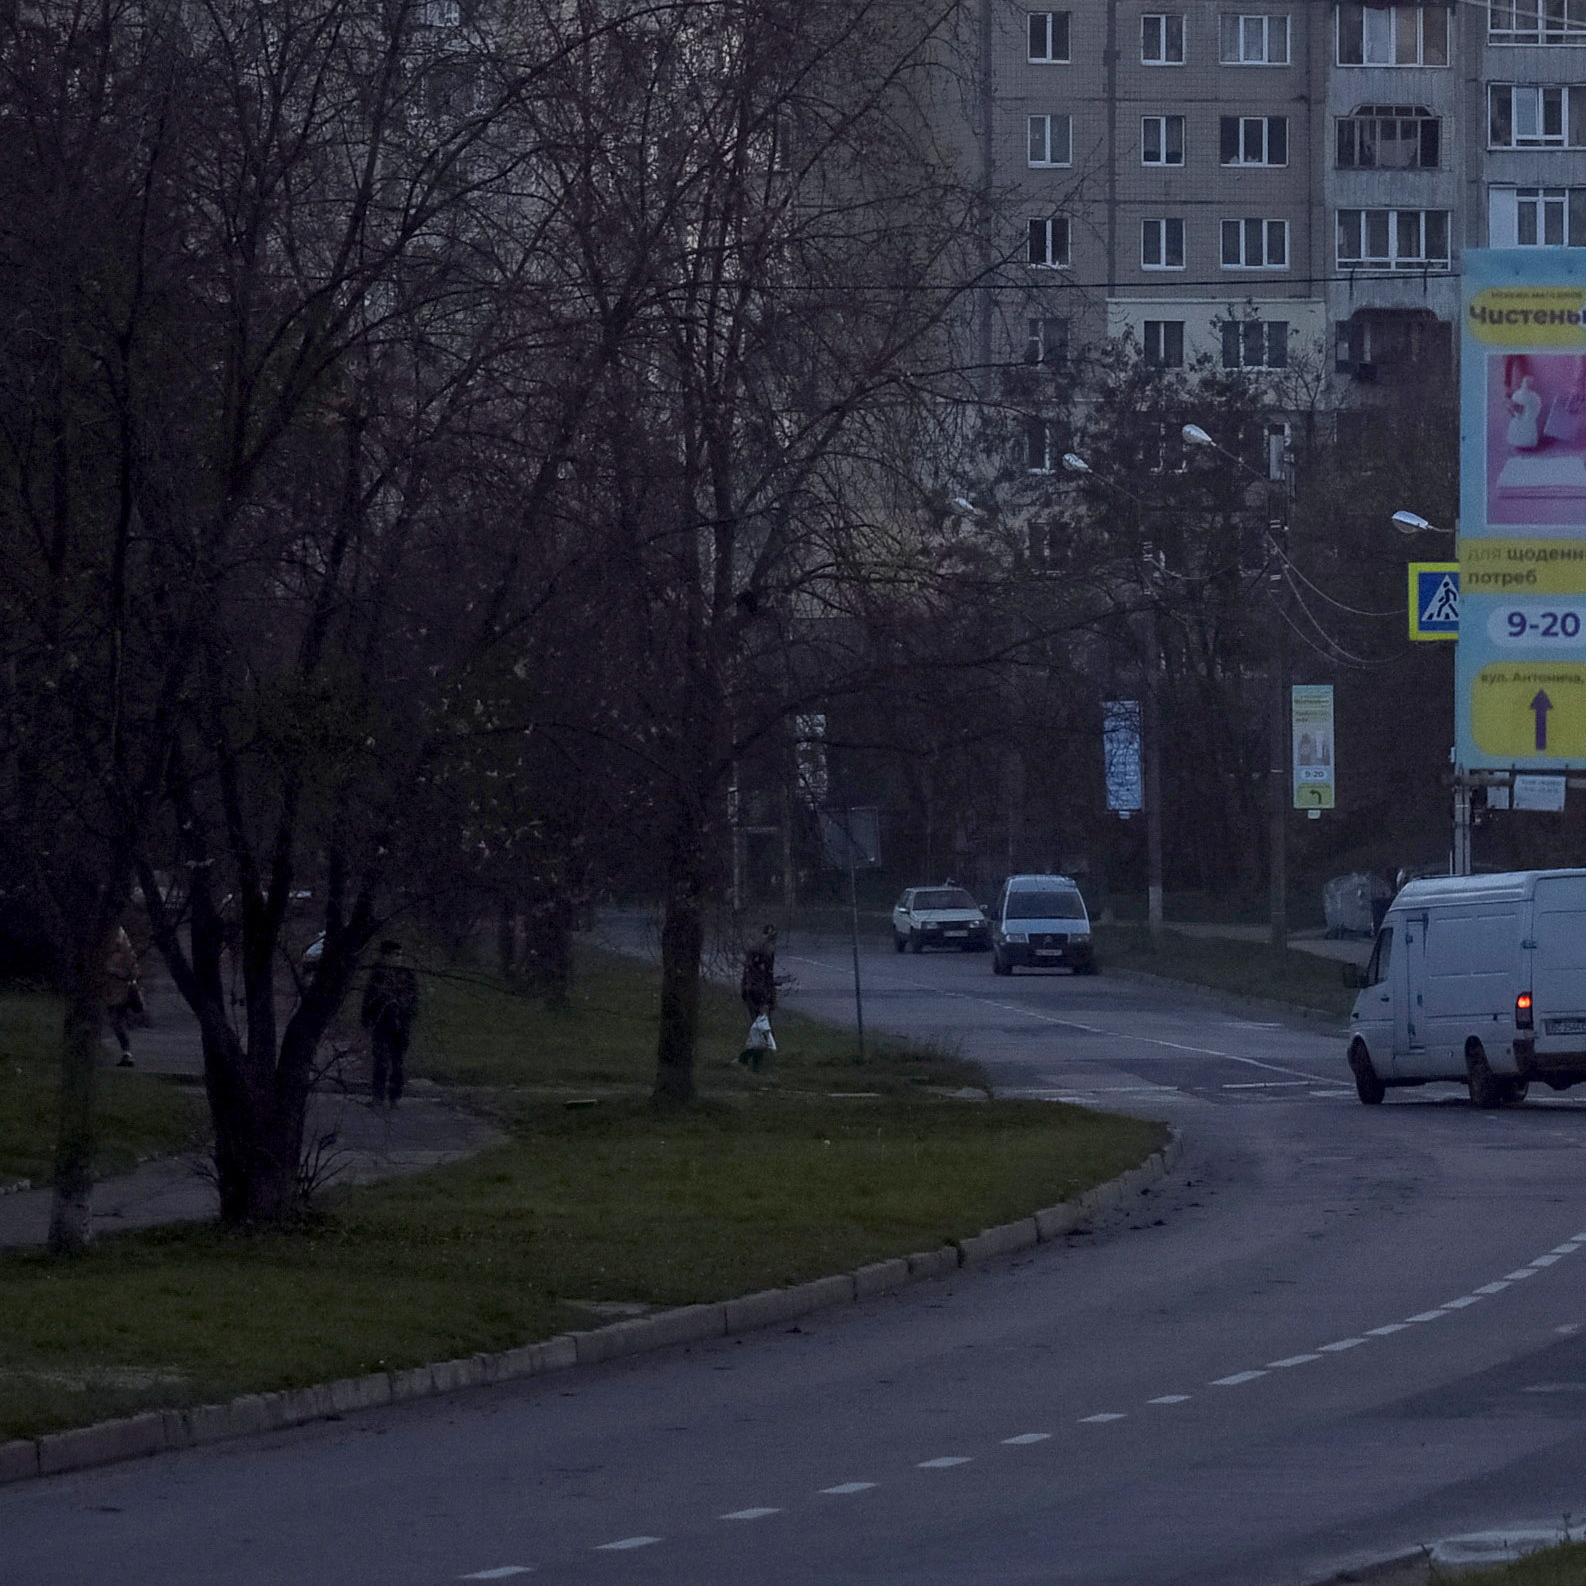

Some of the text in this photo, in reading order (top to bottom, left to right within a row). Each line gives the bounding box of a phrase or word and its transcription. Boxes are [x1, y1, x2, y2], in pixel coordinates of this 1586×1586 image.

[1468, 548, 1500, 561] для
[1467, 568, 1538, 587] потреб
[1507, 611, 1581, 638] 9-20
